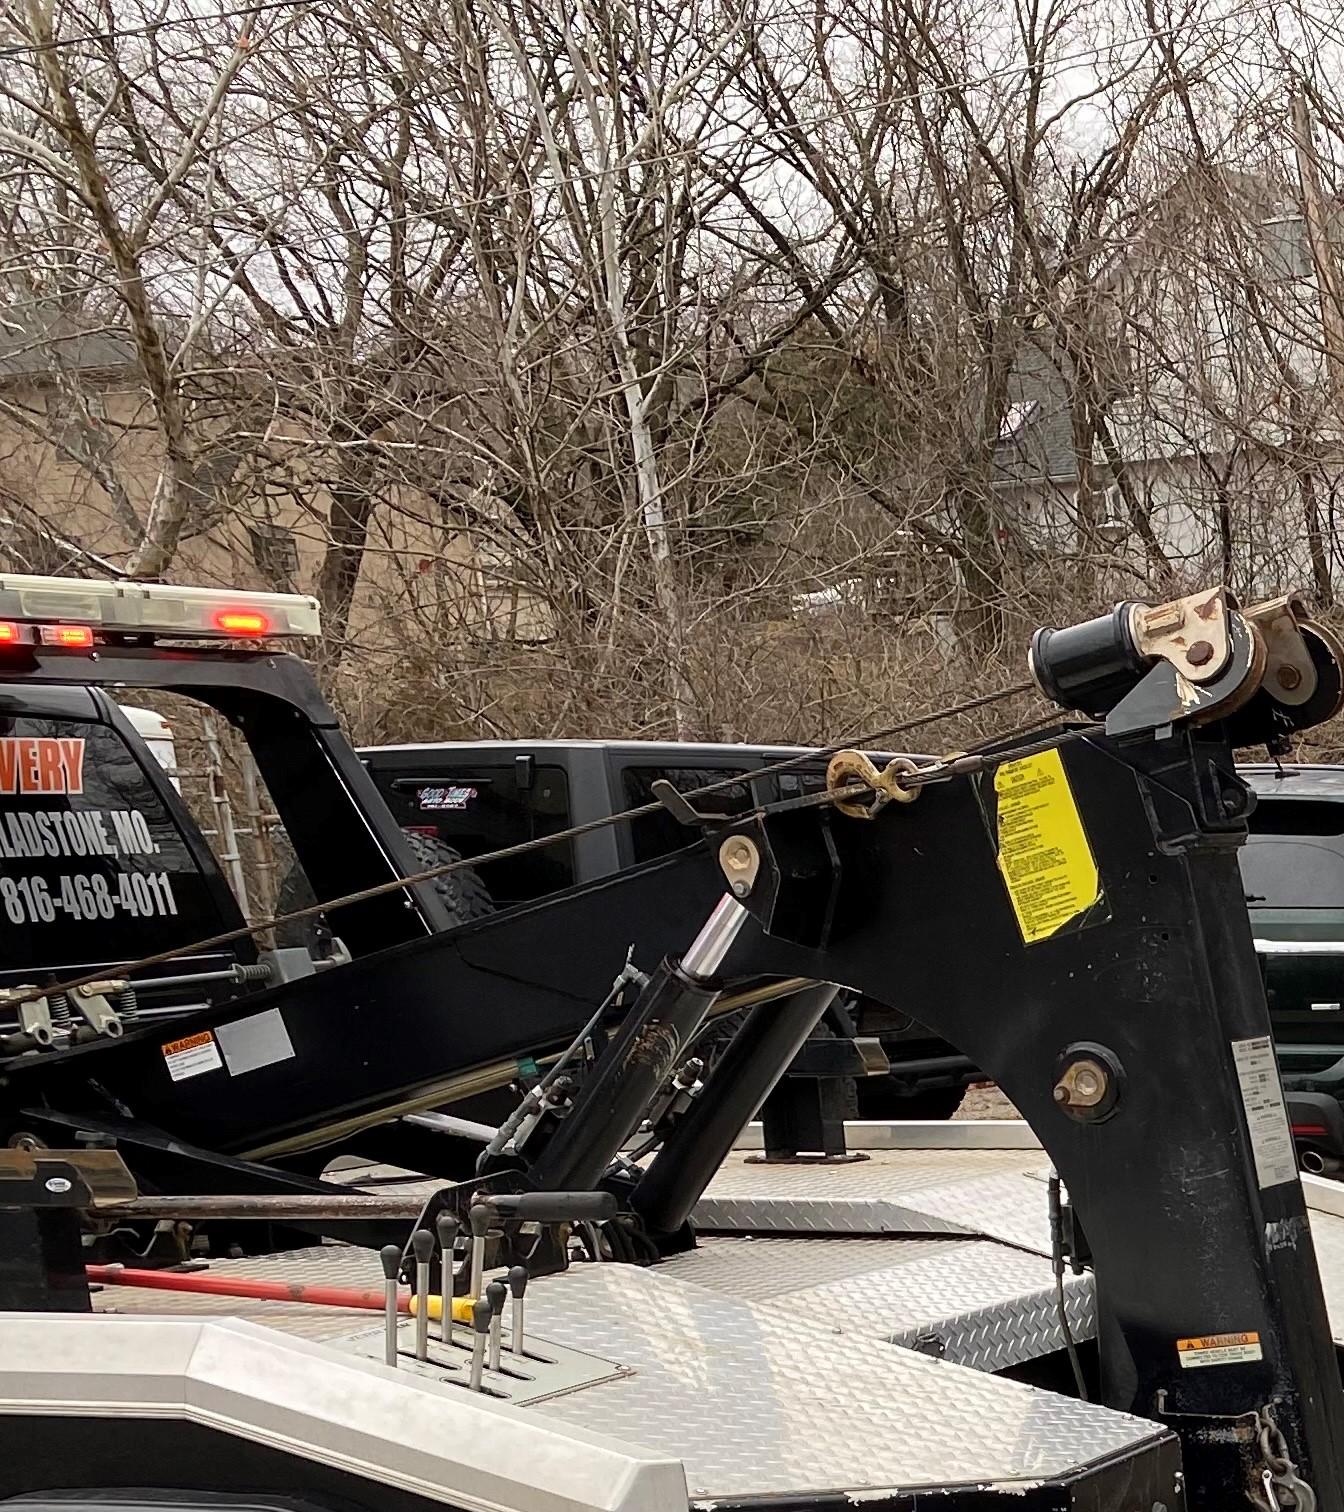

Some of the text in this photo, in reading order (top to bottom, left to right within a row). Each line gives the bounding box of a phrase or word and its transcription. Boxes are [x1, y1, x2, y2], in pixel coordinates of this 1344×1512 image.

[0, 810, 161, 859] LADSTONE, MO.
[0, 872, 178, 924] 816-468-4011
[1200, 1334, 1249, 1347] WARNING
